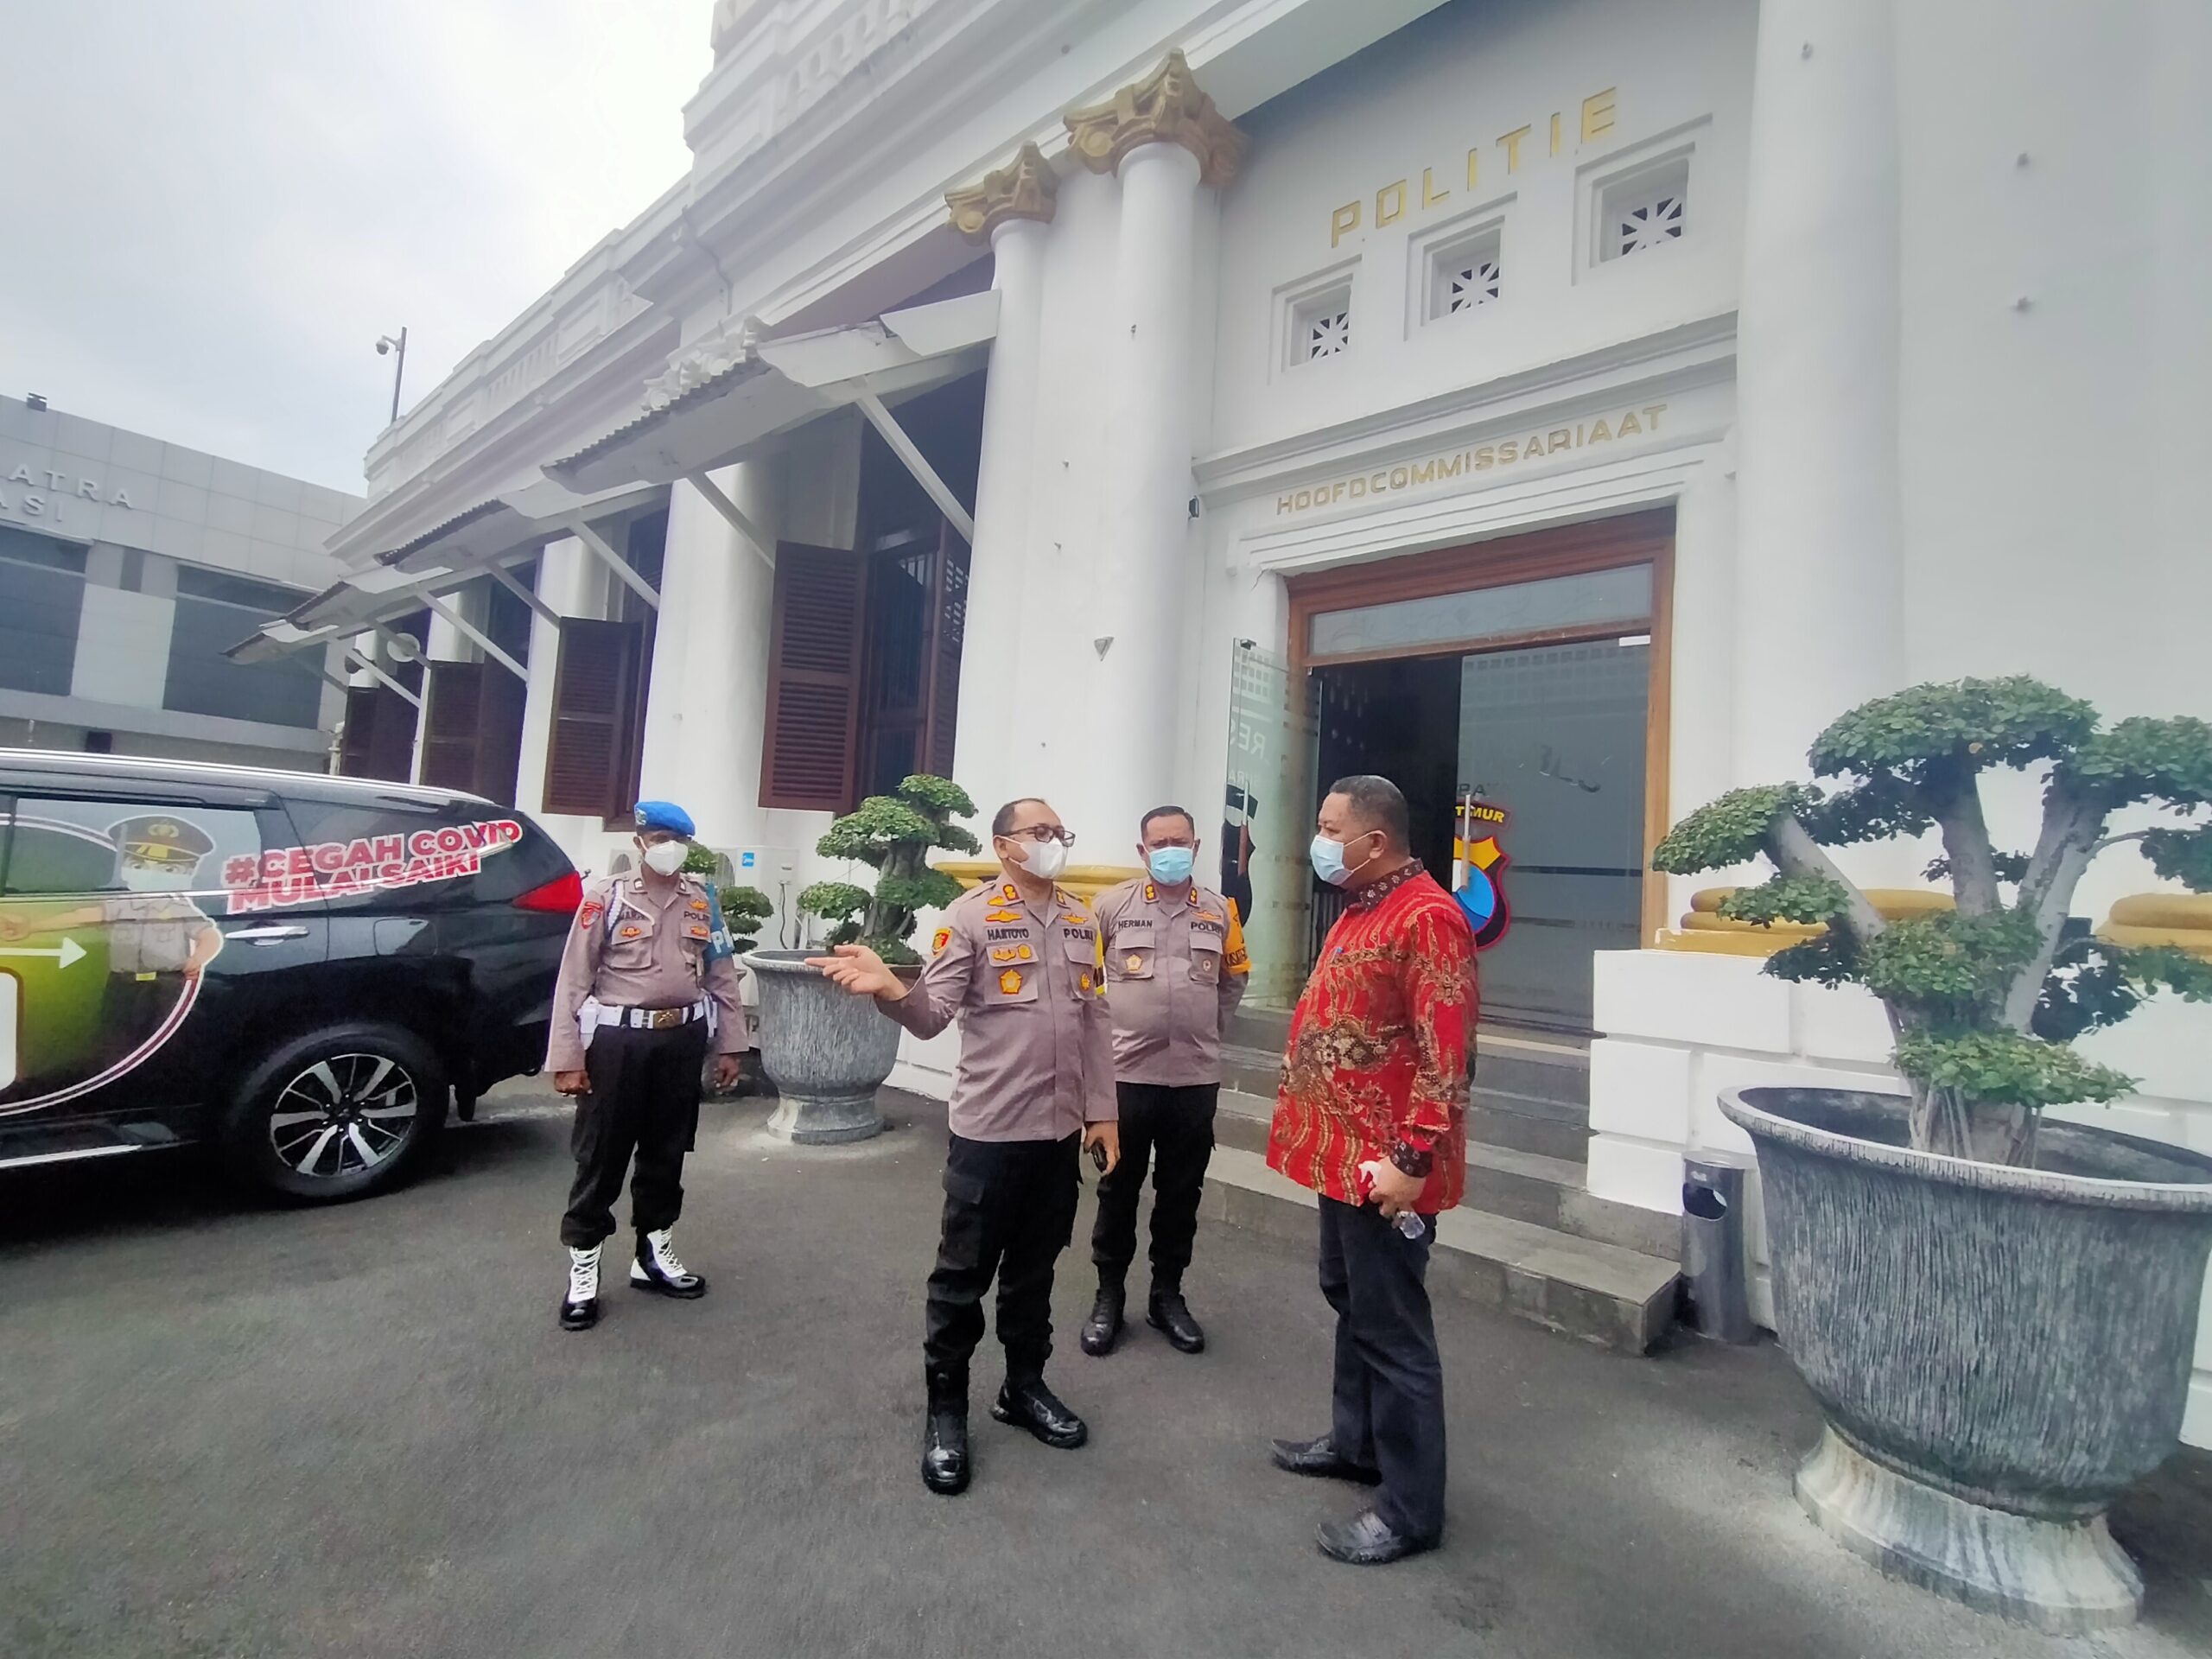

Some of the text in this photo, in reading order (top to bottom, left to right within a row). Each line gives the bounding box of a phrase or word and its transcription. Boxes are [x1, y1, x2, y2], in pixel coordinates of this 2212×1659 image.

[1331, 86, 1617, 249] POLITIE
[1276, 404, 1669, 516] HOOFDCOMMISSARIAAT
[1455, 805, 1505, 823] TMUR
[223, 820, 522, 887] #CEGAH COVID
[228, 854, 480, 913] MULAI SAIKI
[1063, 928, 1094, 942] POLRI
[1118, 919, 1154, 930] HERMAN
